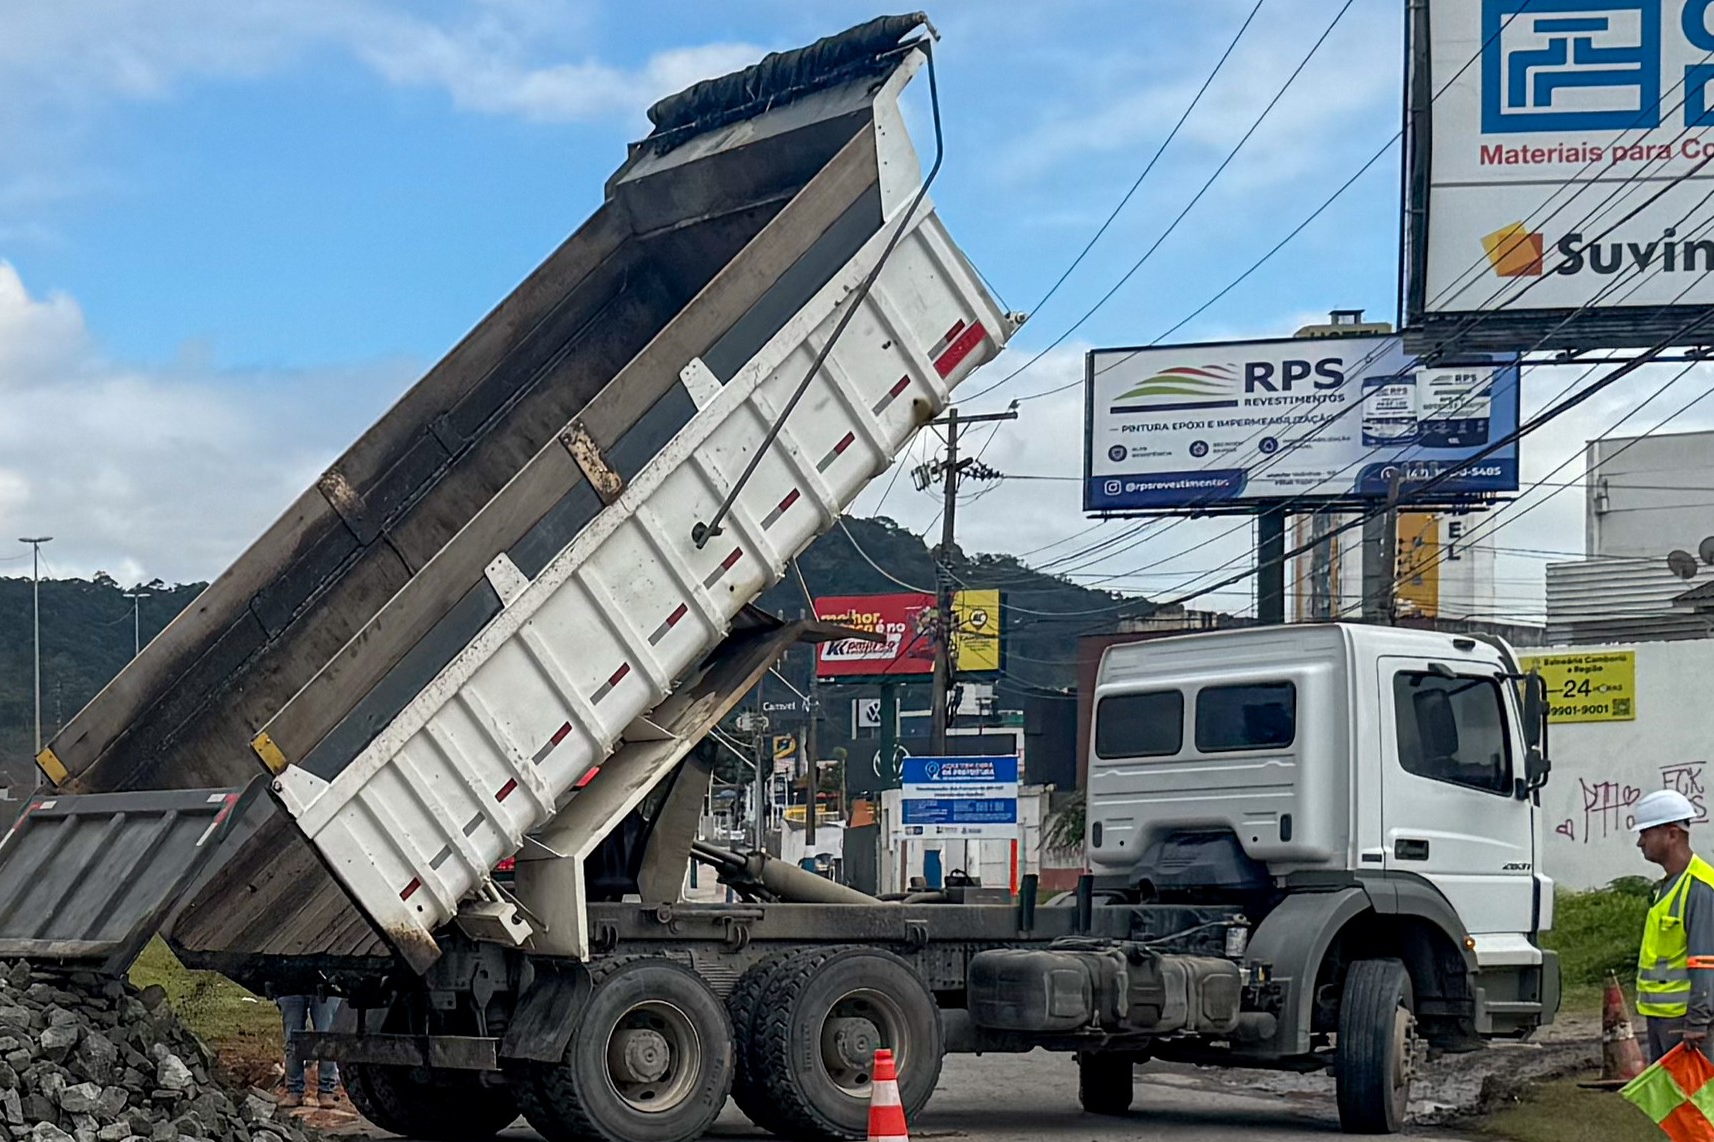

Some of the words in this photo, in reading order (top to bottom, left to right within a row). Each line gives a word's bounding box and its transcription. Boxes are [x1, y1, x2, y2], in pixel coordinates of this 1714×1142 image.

[1480, 142, 1603, 166] Materiais
[1612, 144, 1671, 166] para
[1557, 227, 1714, 276] Suvin
[1244, 358, 1345, 394] RPS
[1244, 393, 1345, 407] REVESTIMENTOS
[1121, 424, 1169, 434] PINTURA
[1172, 420, 1205, 431] EPÓXI
[1207, 420, 1214, 429] E
[886, 621, 906, 634] no
[1543, 656, 1583, 666] Balneário
[1574, 665, 1604, 674] Região
[1562, 678, 1592, 698] 24
